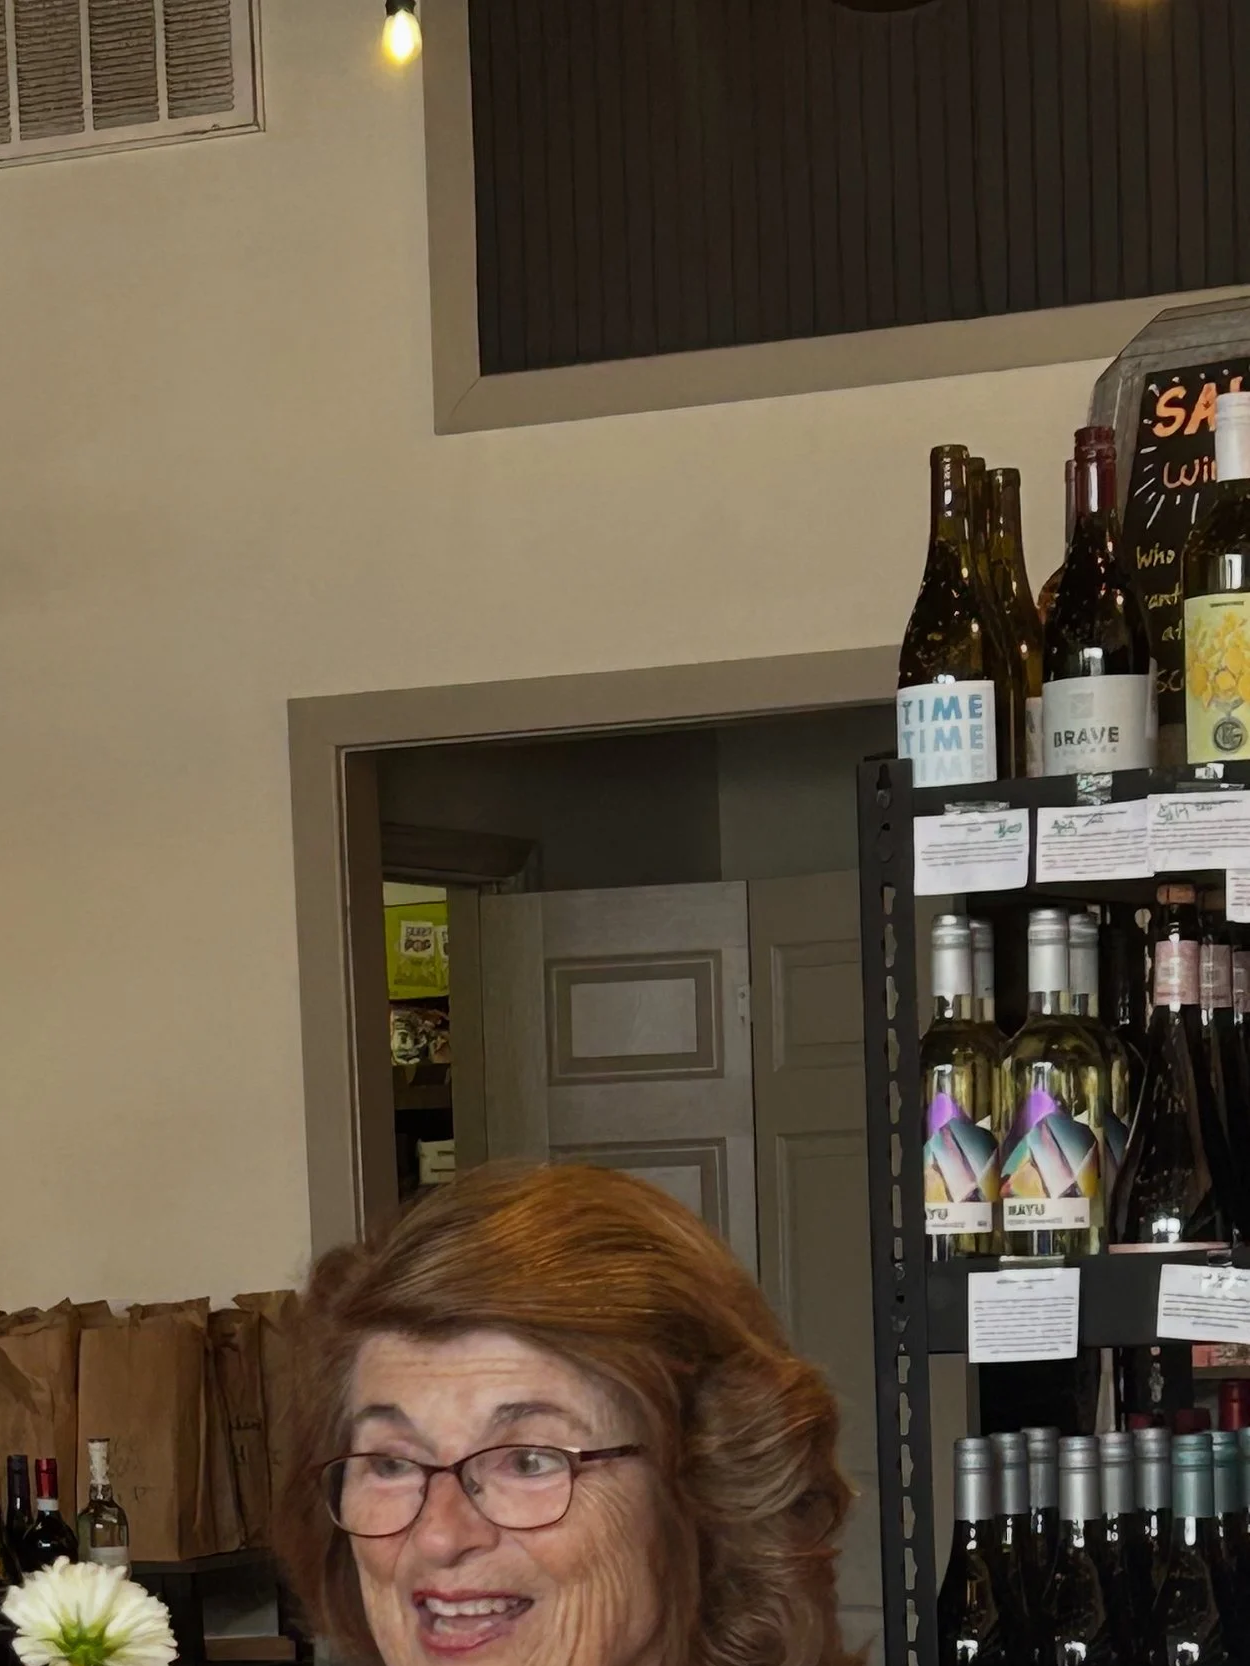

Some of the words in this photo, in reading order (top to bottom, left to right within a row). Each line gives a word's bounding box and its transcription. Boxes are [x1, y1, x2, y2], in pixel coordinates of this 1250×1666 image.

[1153, 376, 1243, 437] SA
[902, 694, 983, 724] TIME
[902, 724, 984, 754] TIME
[1053, 726, 1120, 748] BRAVE
